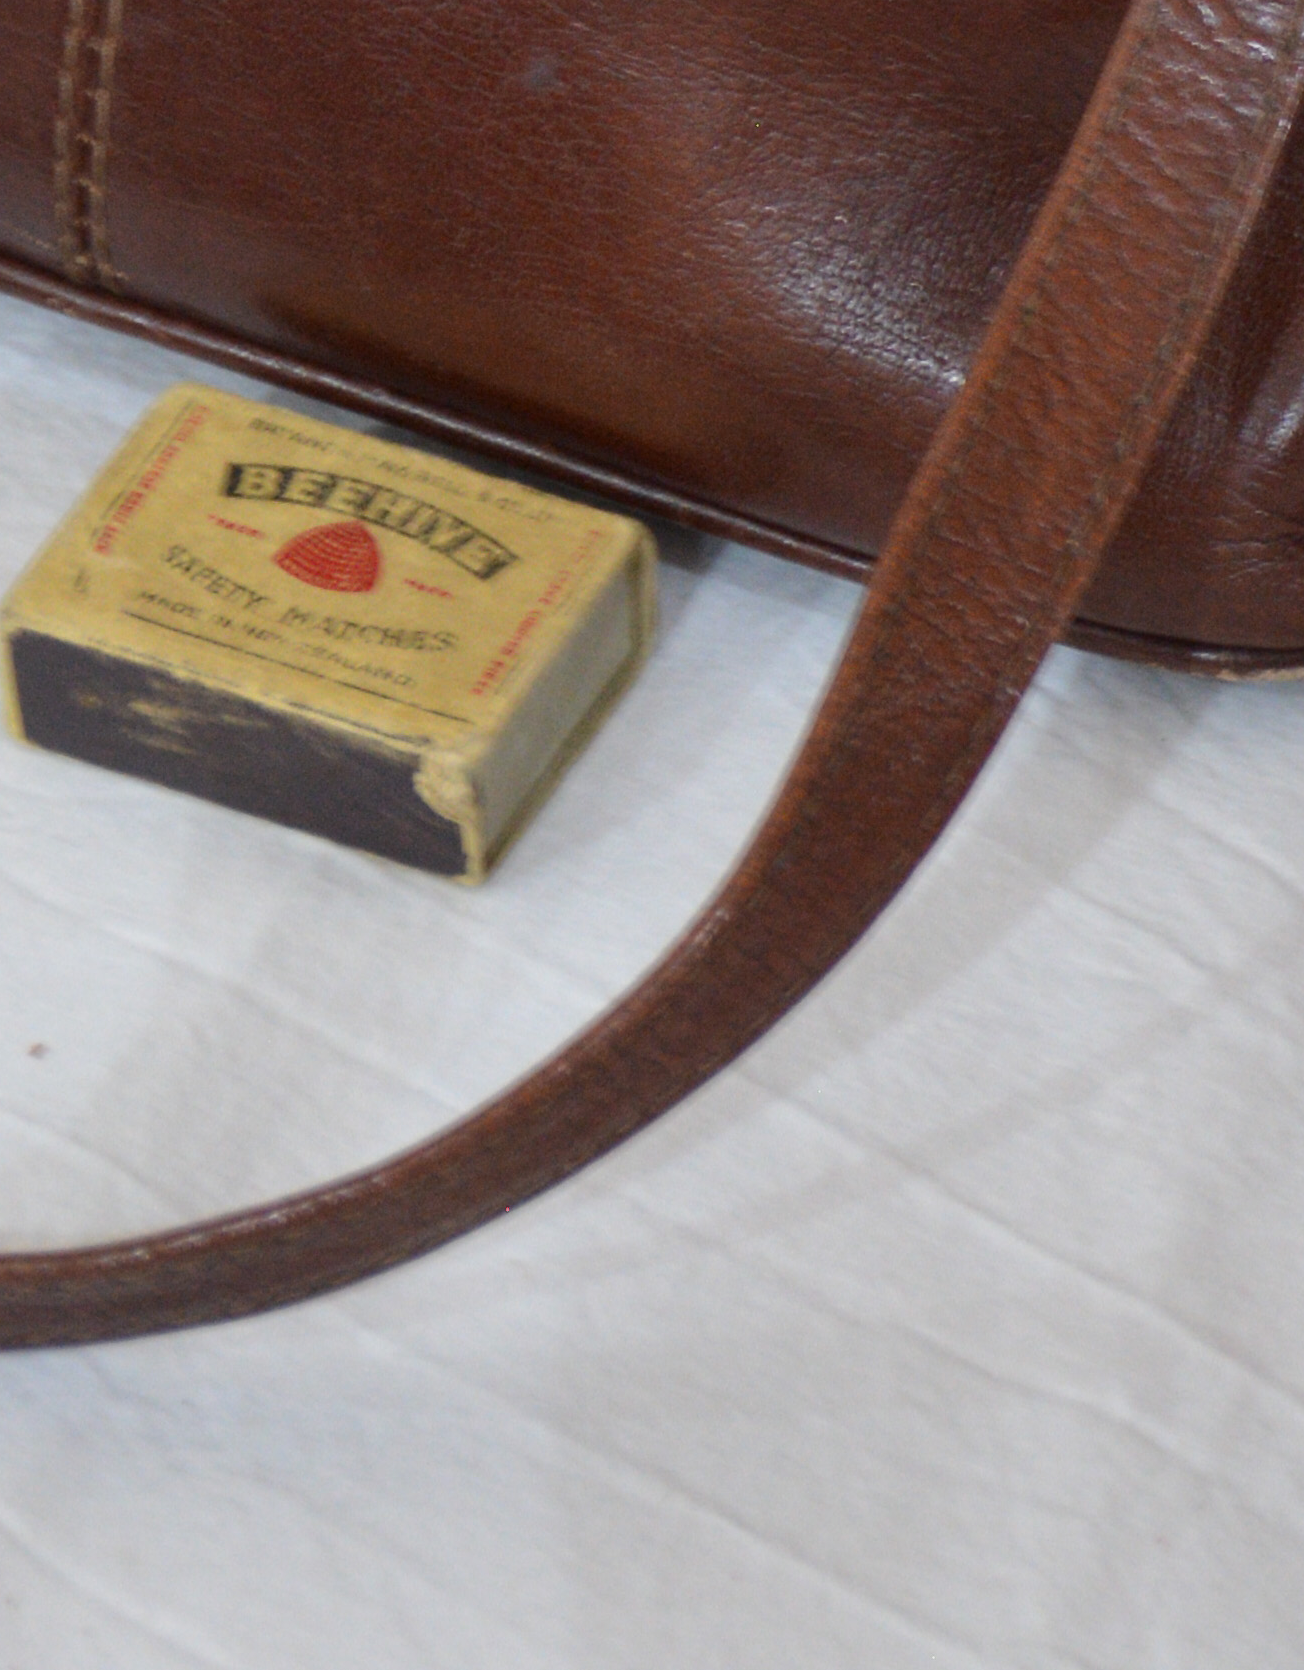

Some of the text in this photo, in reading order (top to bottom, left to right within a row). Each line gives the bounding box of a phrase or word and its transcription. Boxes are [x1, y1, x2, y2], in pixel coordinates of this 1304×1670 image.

[237, 463, 508, 575] BEEHIVE
[164, 544, 458, 653] SAFETY MATCHES
